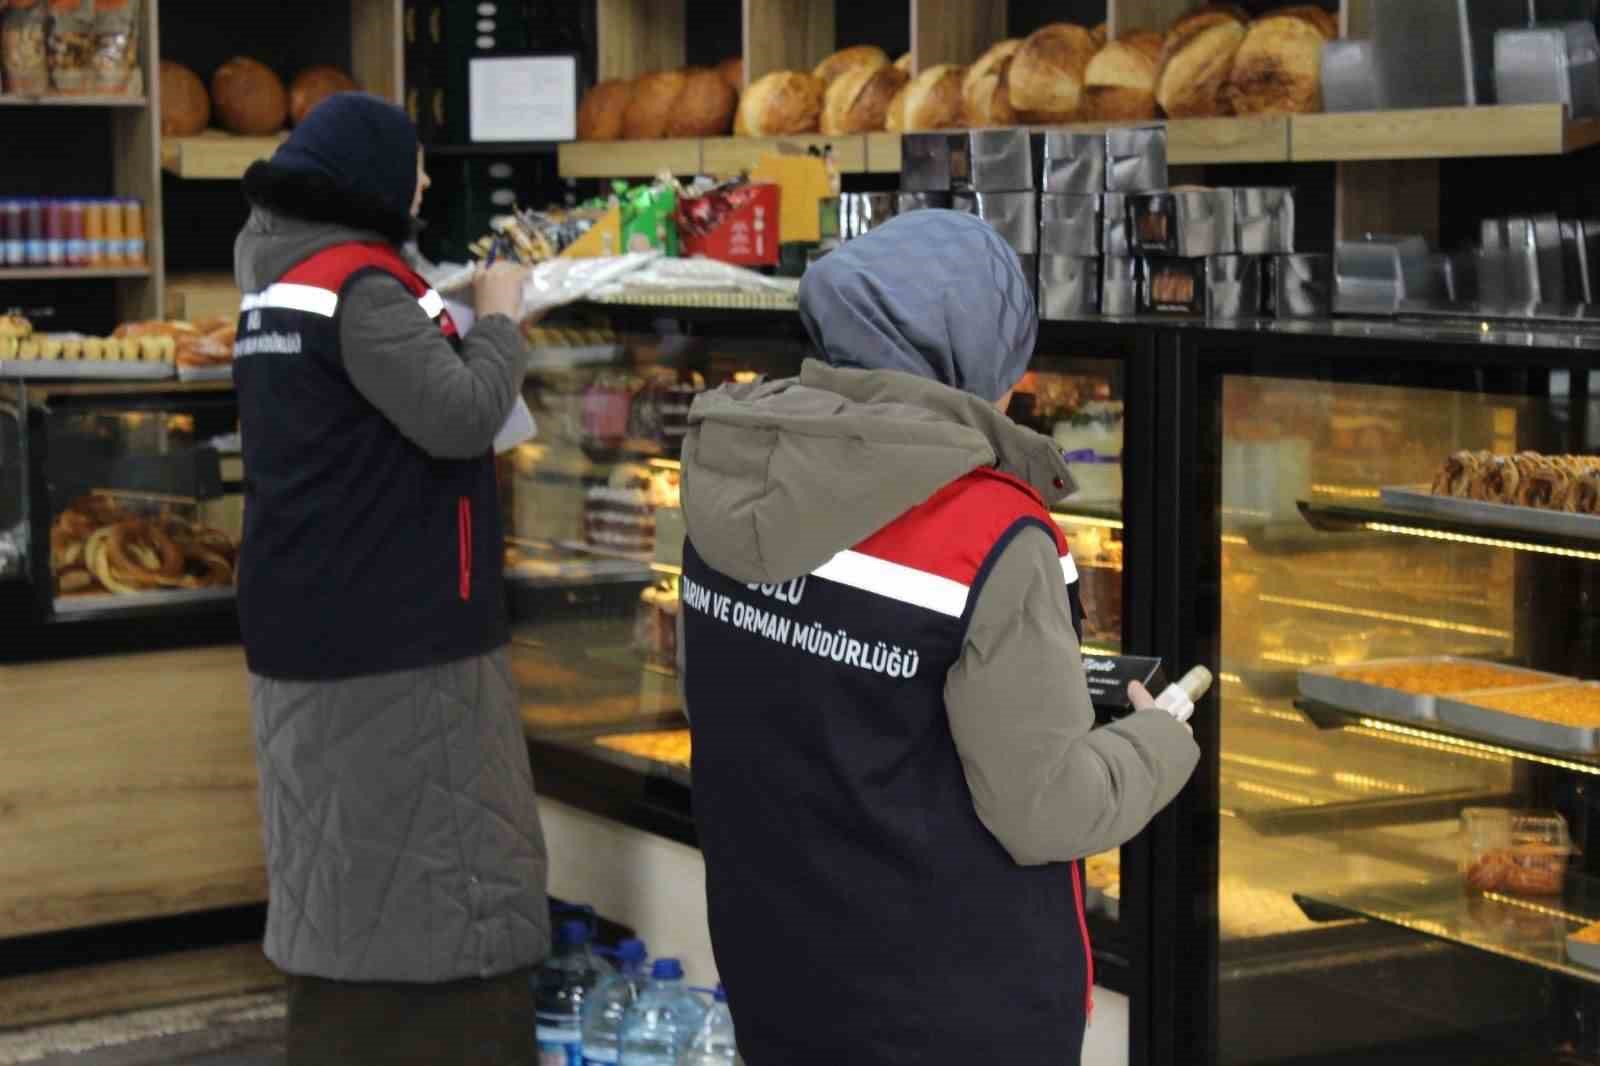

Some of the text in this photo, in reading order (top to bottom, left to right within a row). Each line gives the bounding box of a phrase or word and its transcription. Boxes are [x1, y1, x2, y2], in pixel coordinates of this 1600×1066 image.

[713, 592, 731, 622] VE
[732, 601, 791, 644] ORMAN
[792, 621, 919, 678] MÜDÜRLÜĞÜ
